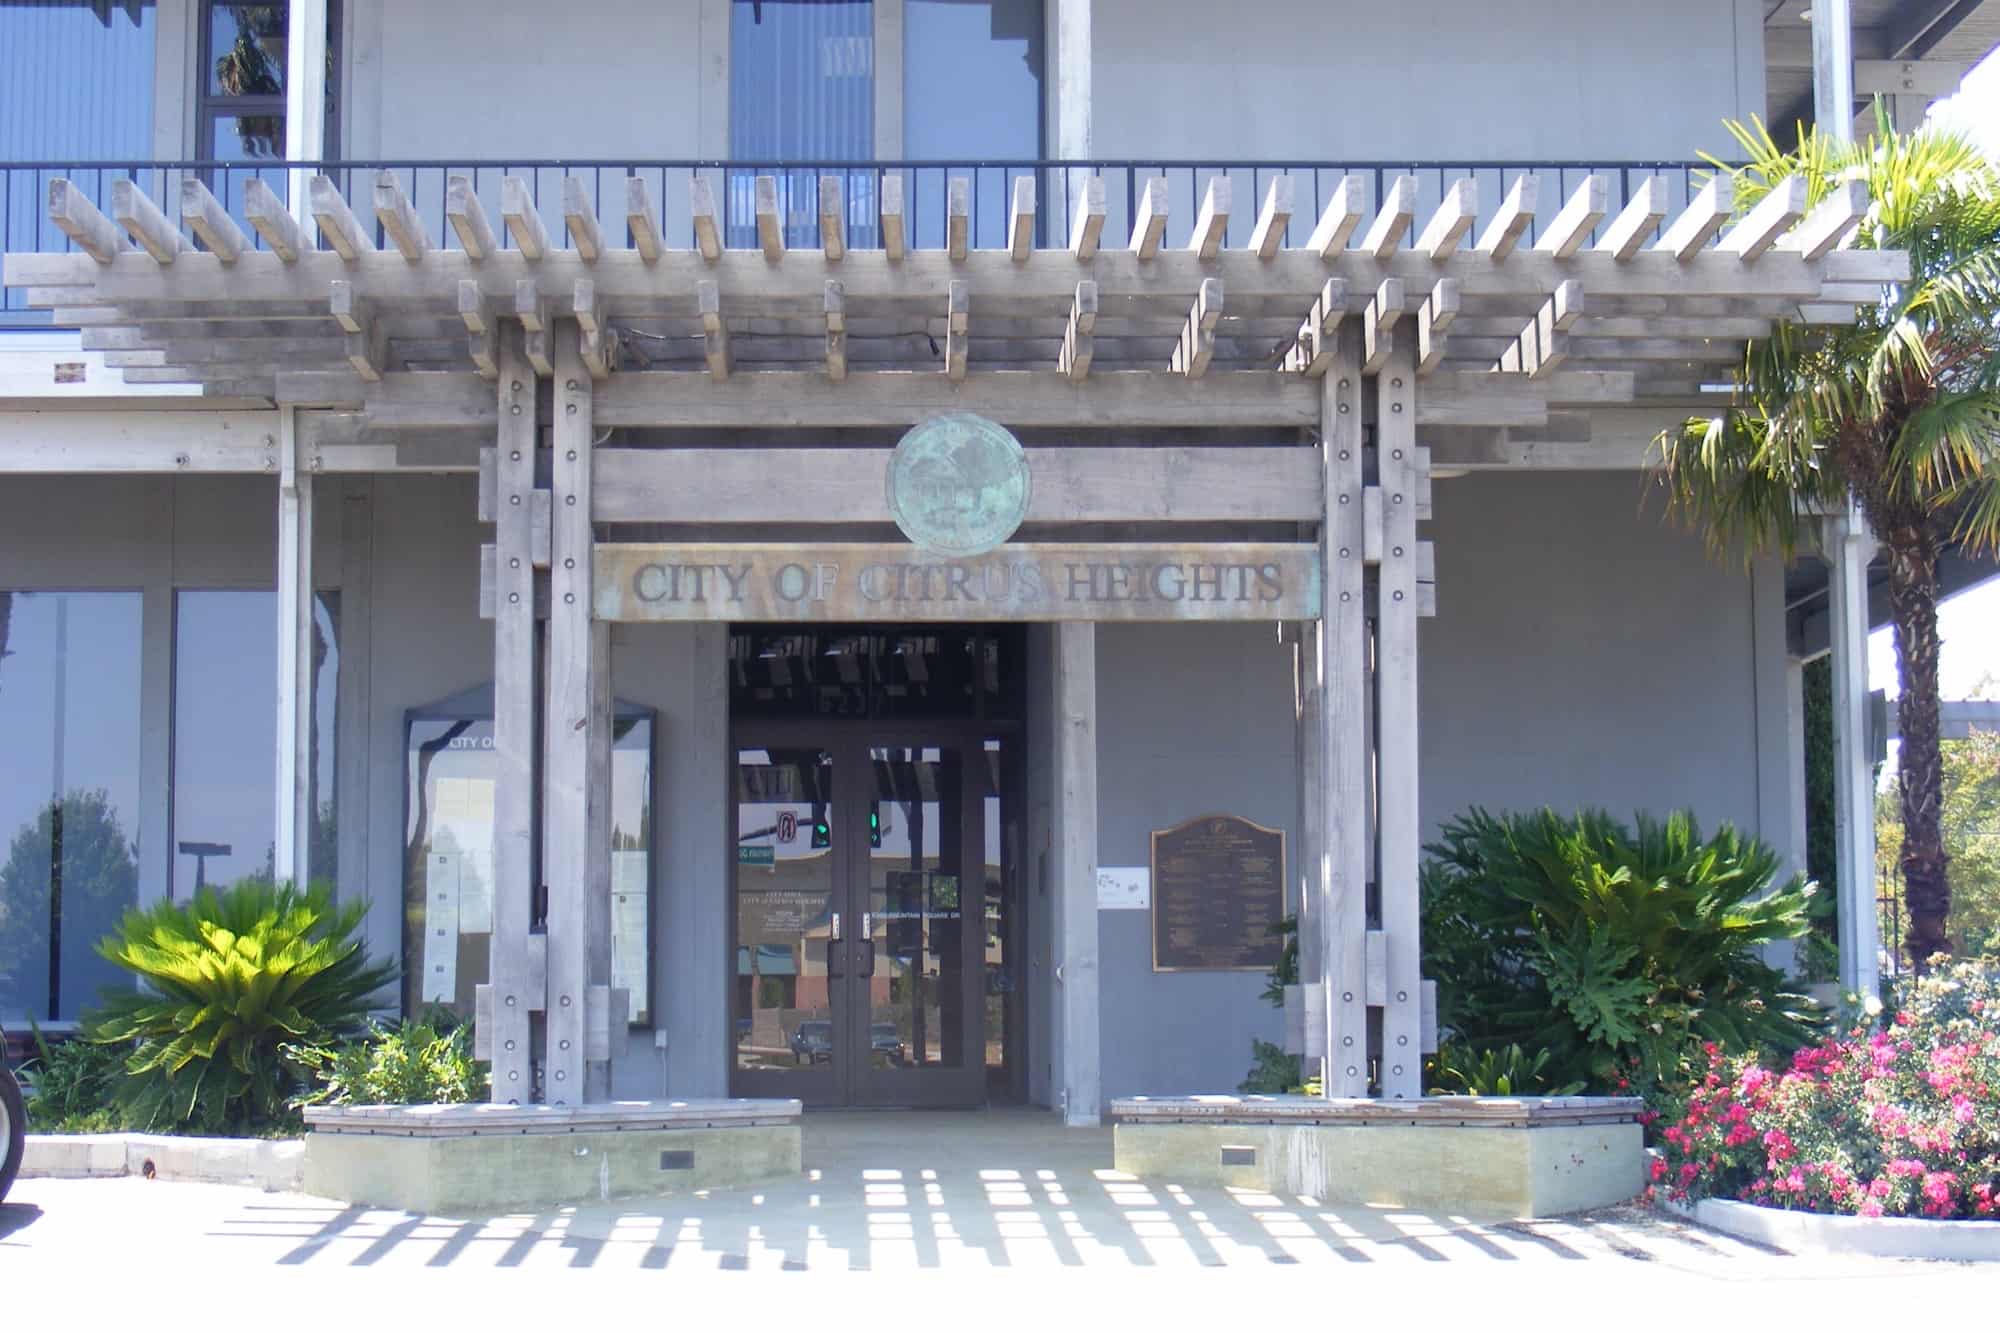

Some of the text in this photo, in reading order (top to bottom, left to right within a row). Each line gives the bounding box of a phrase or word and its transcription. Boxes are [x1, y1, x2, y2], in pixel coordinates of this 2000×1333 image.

[633, 562, 1284, 602] CITY OF CITRUS HEIGHTS
[448, 736, 480, 749] CITY
